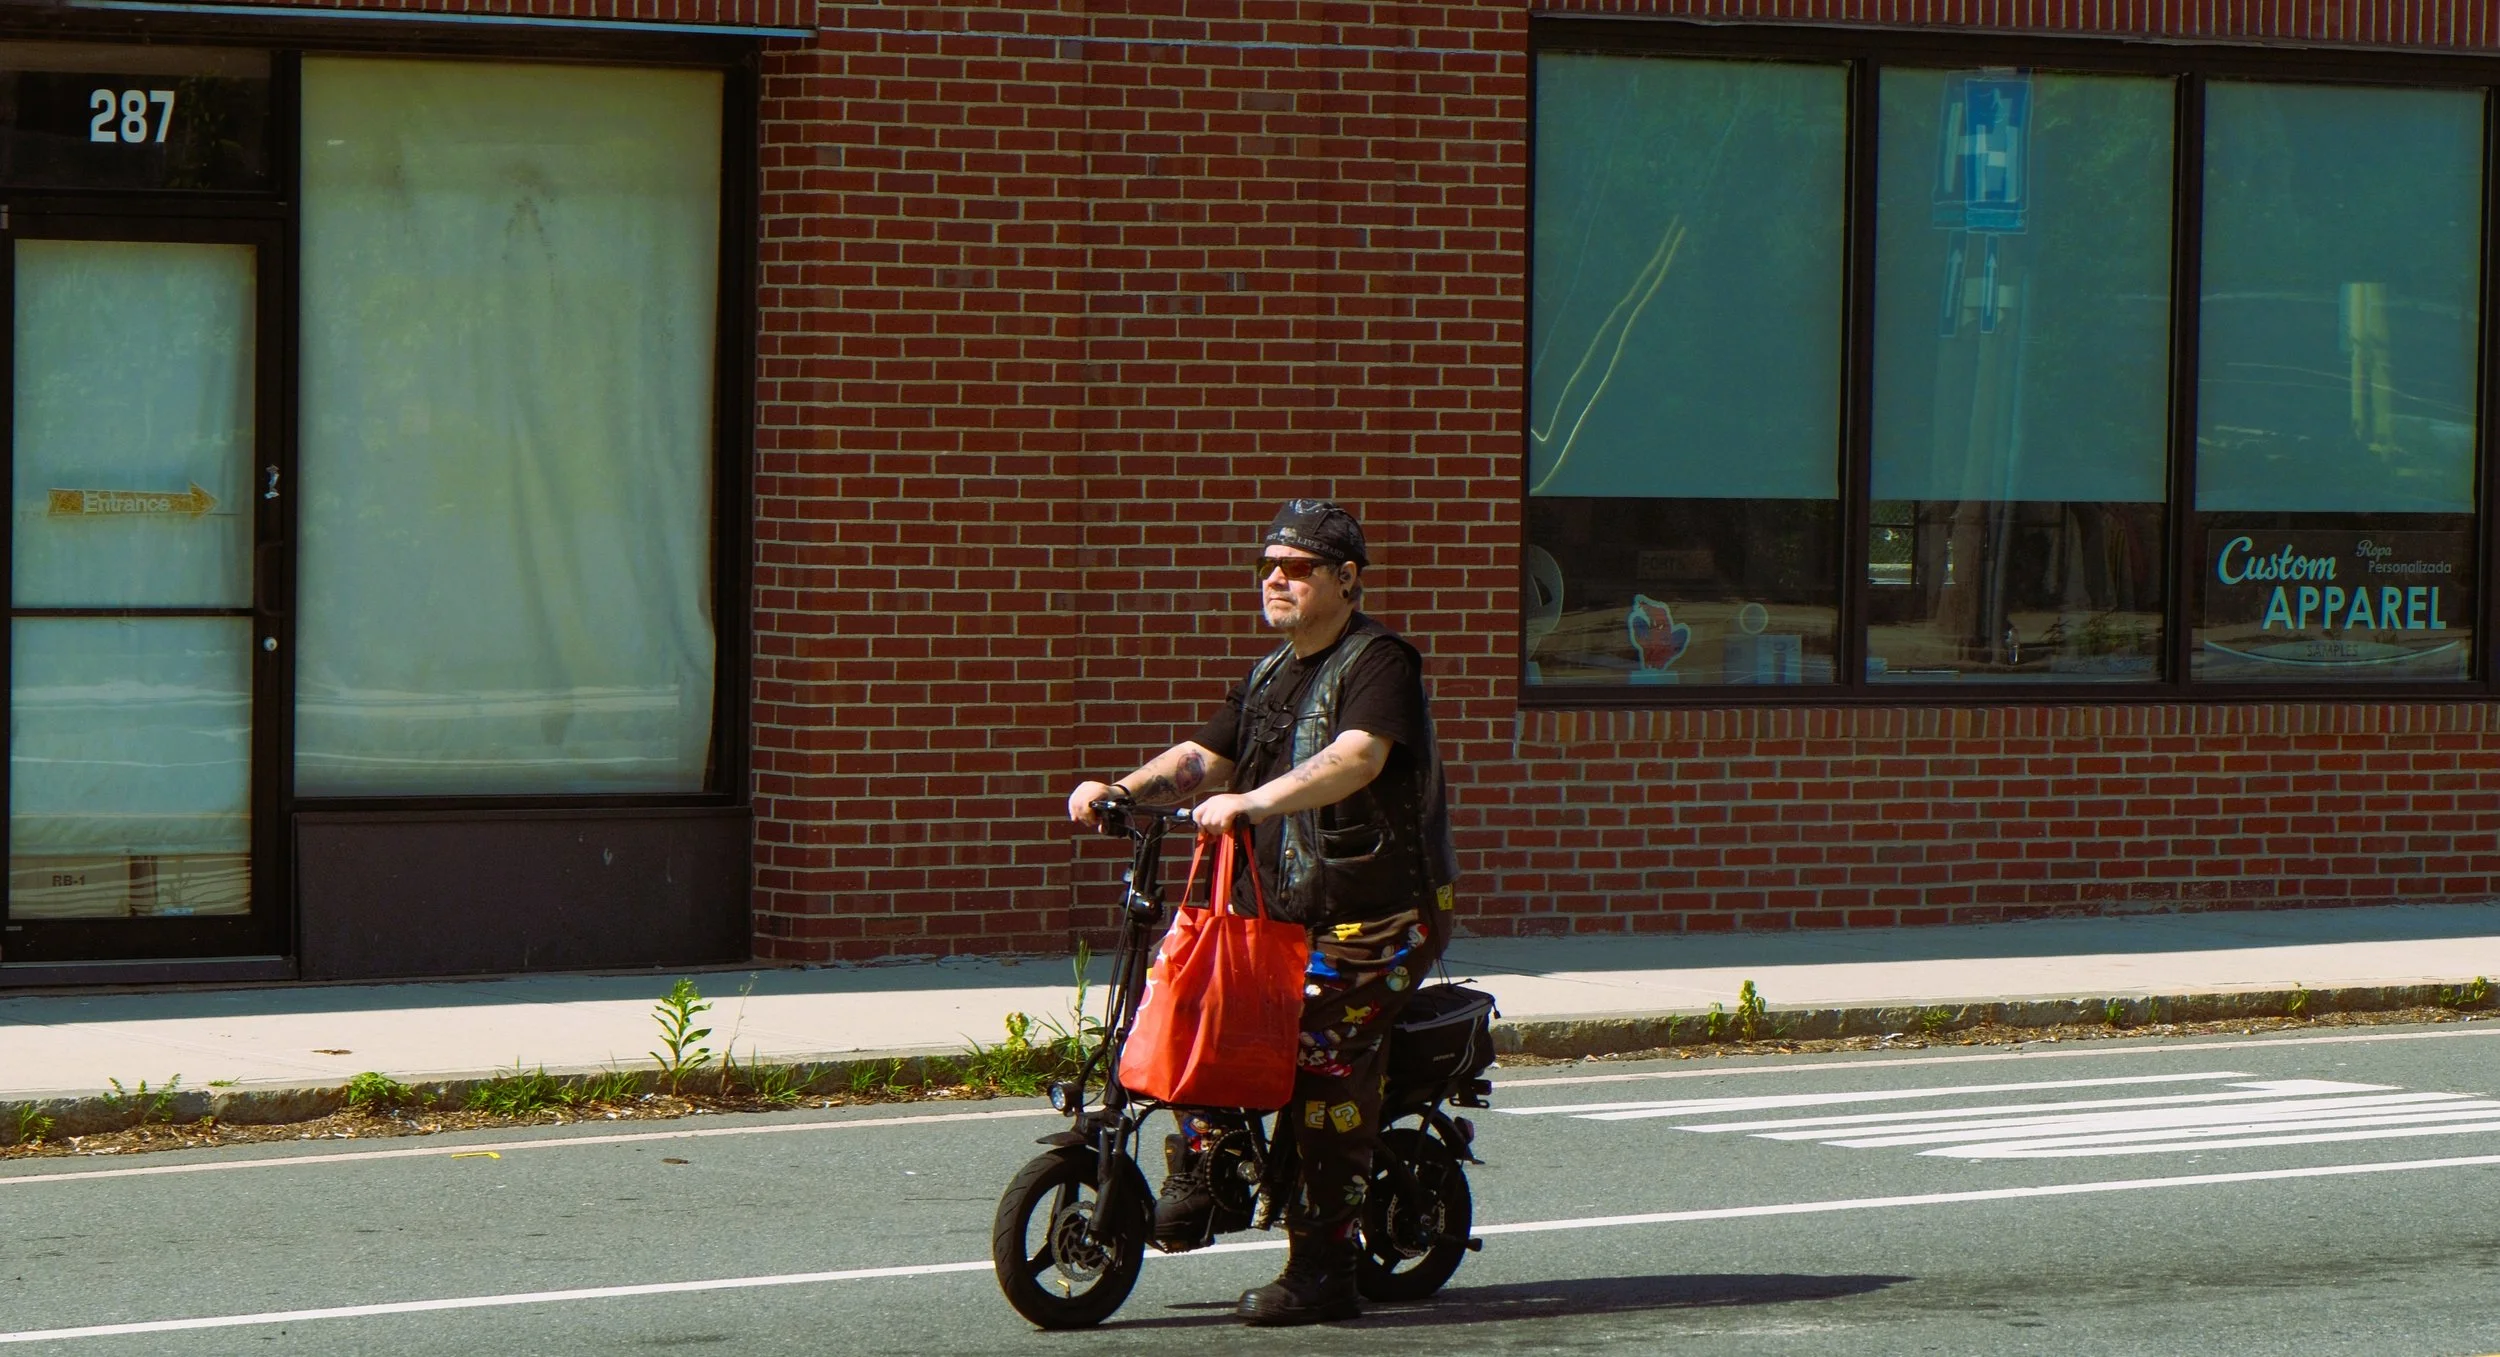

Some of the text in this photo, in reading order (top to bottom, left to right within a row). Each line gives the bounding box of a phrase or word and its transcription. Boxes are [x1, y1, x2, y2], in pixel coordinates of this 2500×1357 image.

[90, 88, 175, 143] 287
[84, 493, 170, 514] Entrance
[1297, 536, 1320, 550] LIVE
[2356, 539, 2392, 562] Ropa
[2217, 536, 2337, 585] Custom
[2367, 560, 2452, 574] Personalizada
[2261, 586, 2447, 630] APPAREL
[2306, 643, 2359, 657] SAMPLES
[52, 875, 86, 887] RB-1
